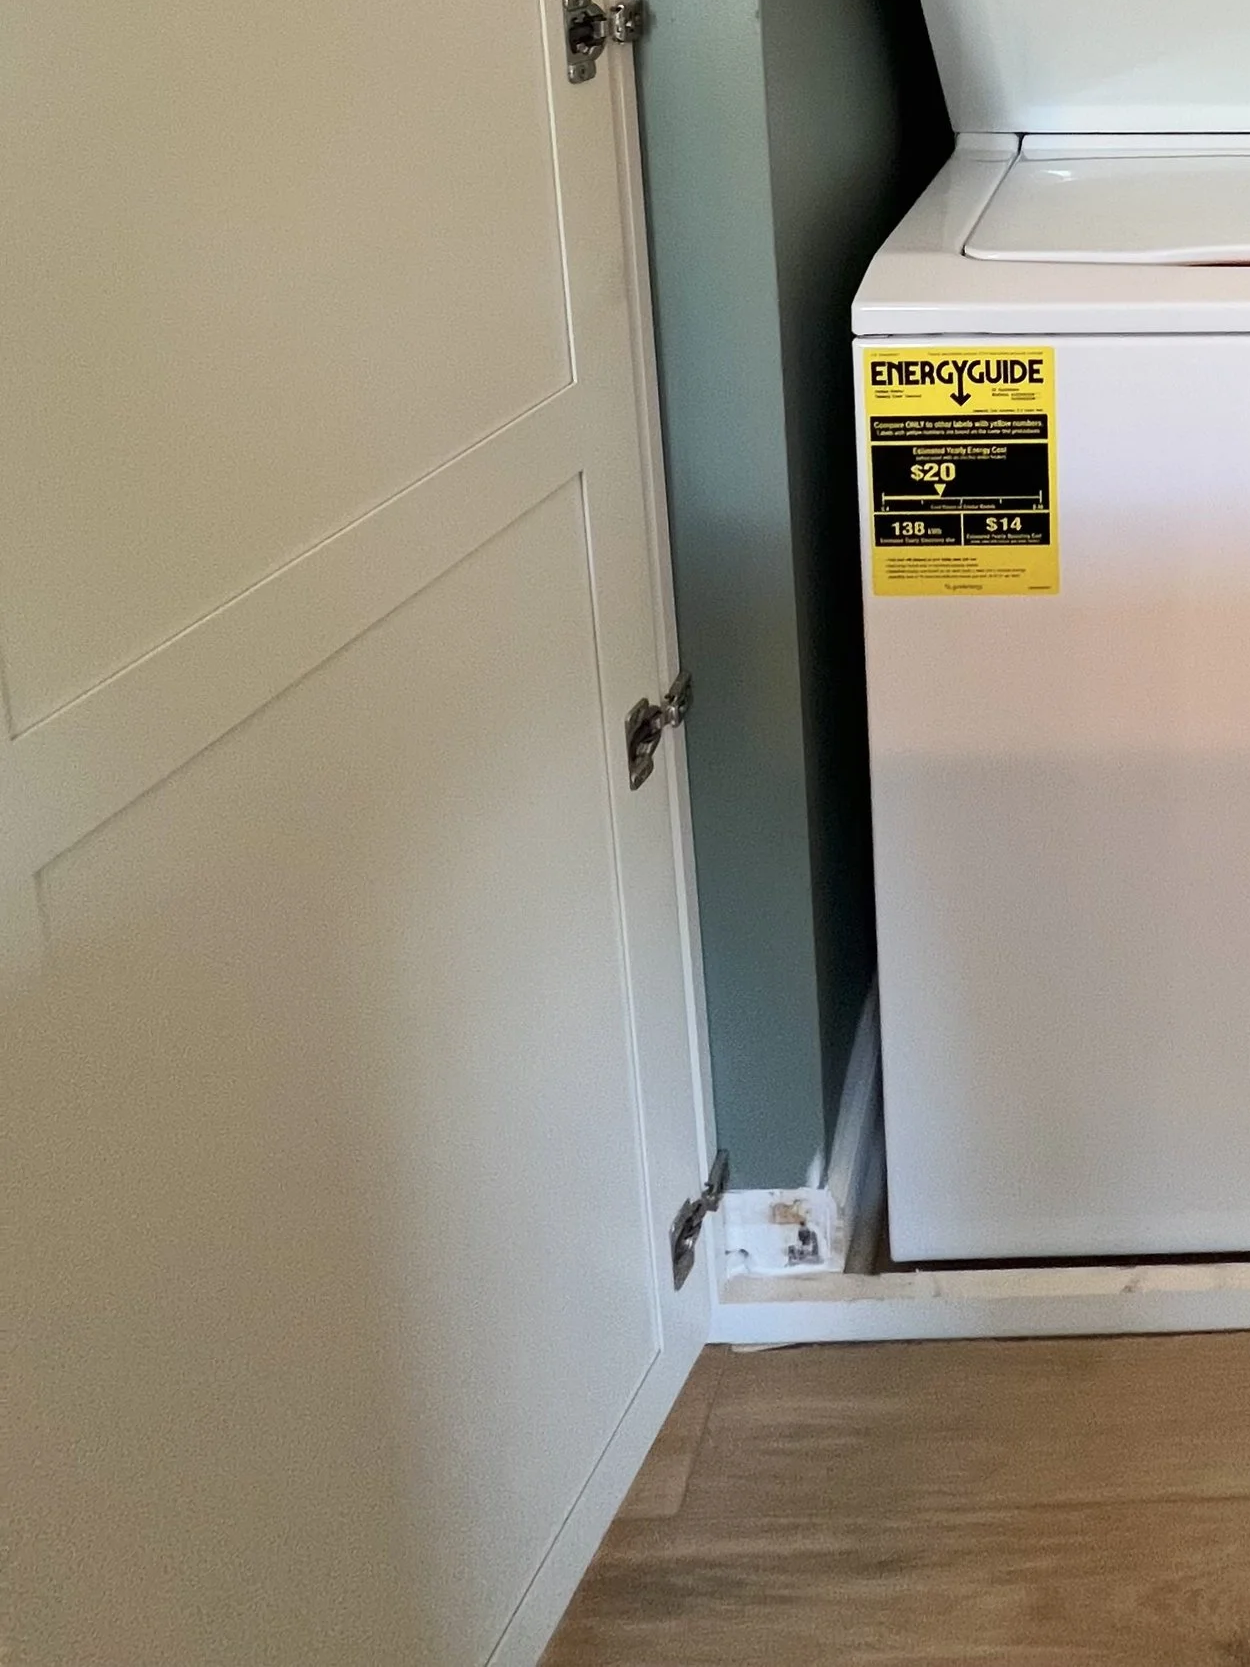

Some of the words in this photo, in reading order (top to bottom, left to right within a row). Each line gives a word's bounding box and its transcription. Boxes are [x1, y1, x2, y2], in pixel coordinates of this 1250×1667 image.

[870, 359, 1044, 386] ENERGYGUIDE
[873, 421, 904, 430] Compare
[905, 420, 924, 428] ONLY
[925, 420, 933, 428] to
[934, 420, 952, 428] other
[953, 420, 973, 428] labels
[975, 419, 989, 427] with
[990, 419, 1011, 429] yellow
[913, 447, 945, 455] Estimated
[947, 447, 966, 455] Yearly
[967, 447, 990, 455] Energy
[991, 446, 1007, 454] Cost
[910, 462, 956, 481] $20
[891, 521, 925, 535] 138
[986, 517, 1022, 532] $14
